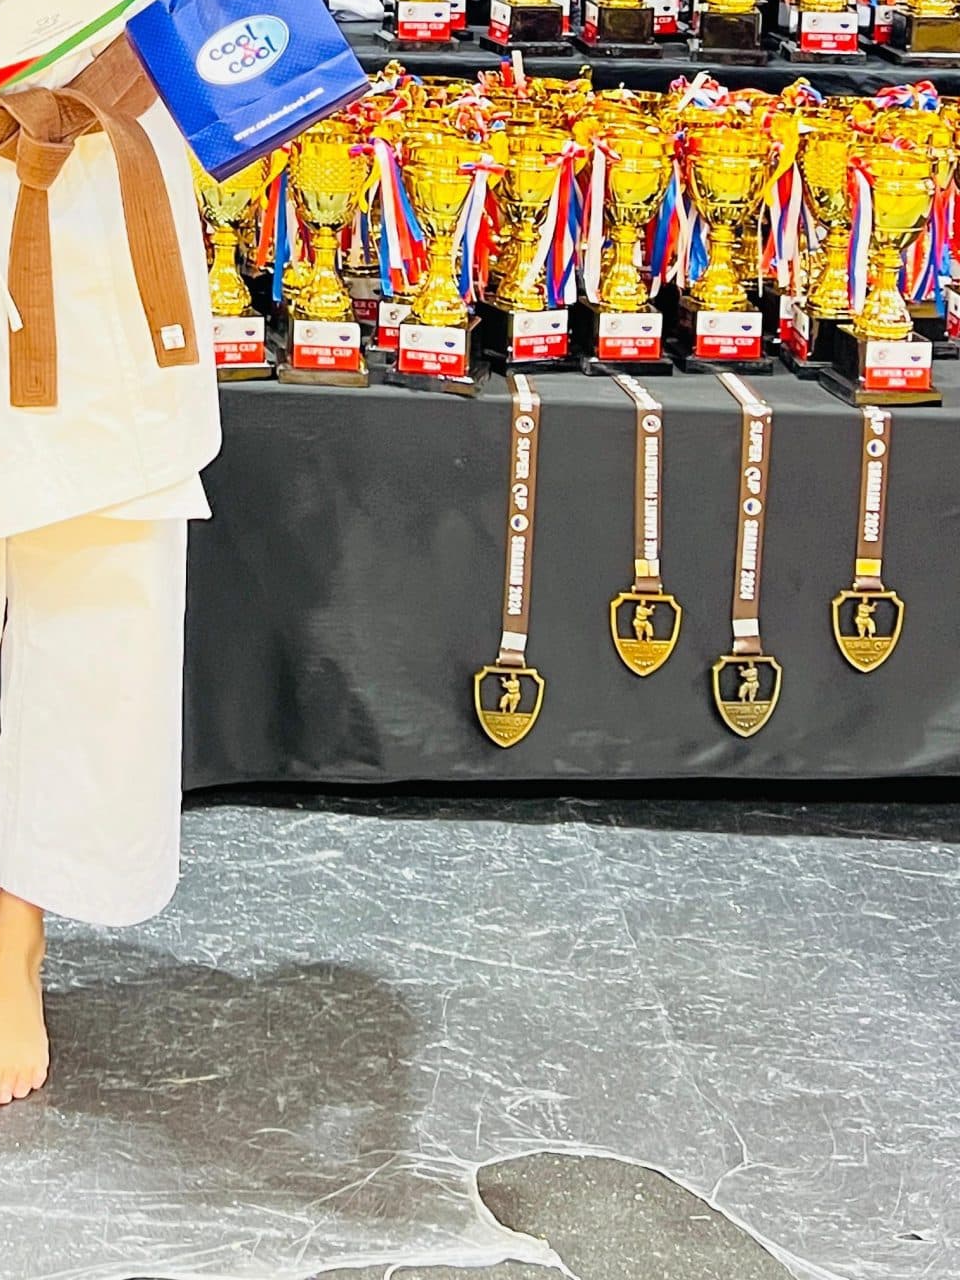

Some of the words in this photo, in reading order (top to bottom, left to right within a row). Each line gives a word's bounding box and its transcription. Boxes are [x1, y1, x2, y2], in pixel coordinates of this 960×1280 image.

[209, 23, 258, 61] cool
[228, 35, 278, 74] cool
[213, 344, 238, 353] UPER
[333, 348, 353, 357] CUP
[749, 420, 764, 463] SUPER
[515, 437, 532, 480] SUPER
[744, 466, 761, 495] CUP
[512, 483, 528, 512] CUP
[507, 585, 524, 616] 2024
